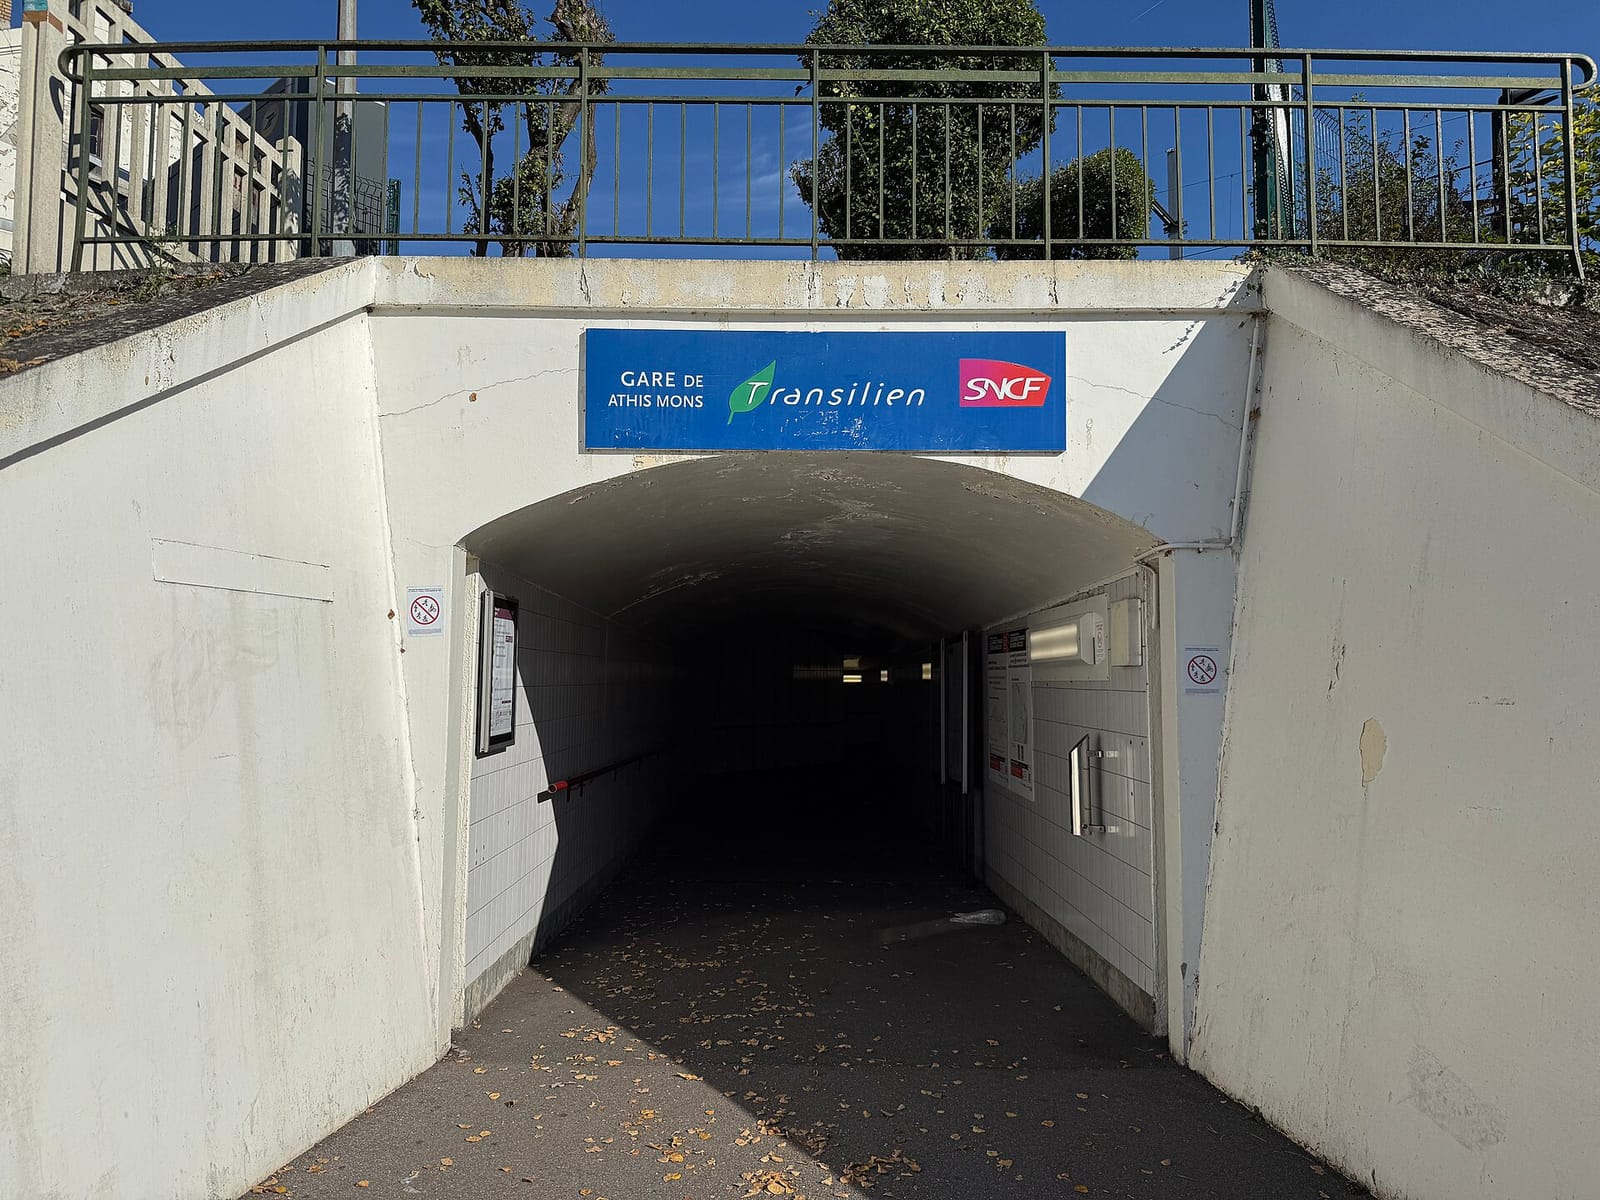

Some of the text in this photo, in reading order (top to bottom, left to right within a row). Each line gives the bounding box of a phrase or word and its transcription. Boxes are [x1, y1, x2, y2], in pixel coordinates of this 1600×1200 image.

[620, 371, 704, 388] GARE DE
[963, 377, 1046, 402] SNCF
[608, 394, 704, 409] ATHIS MONS
[747, 381, 926, 407] Transilien
